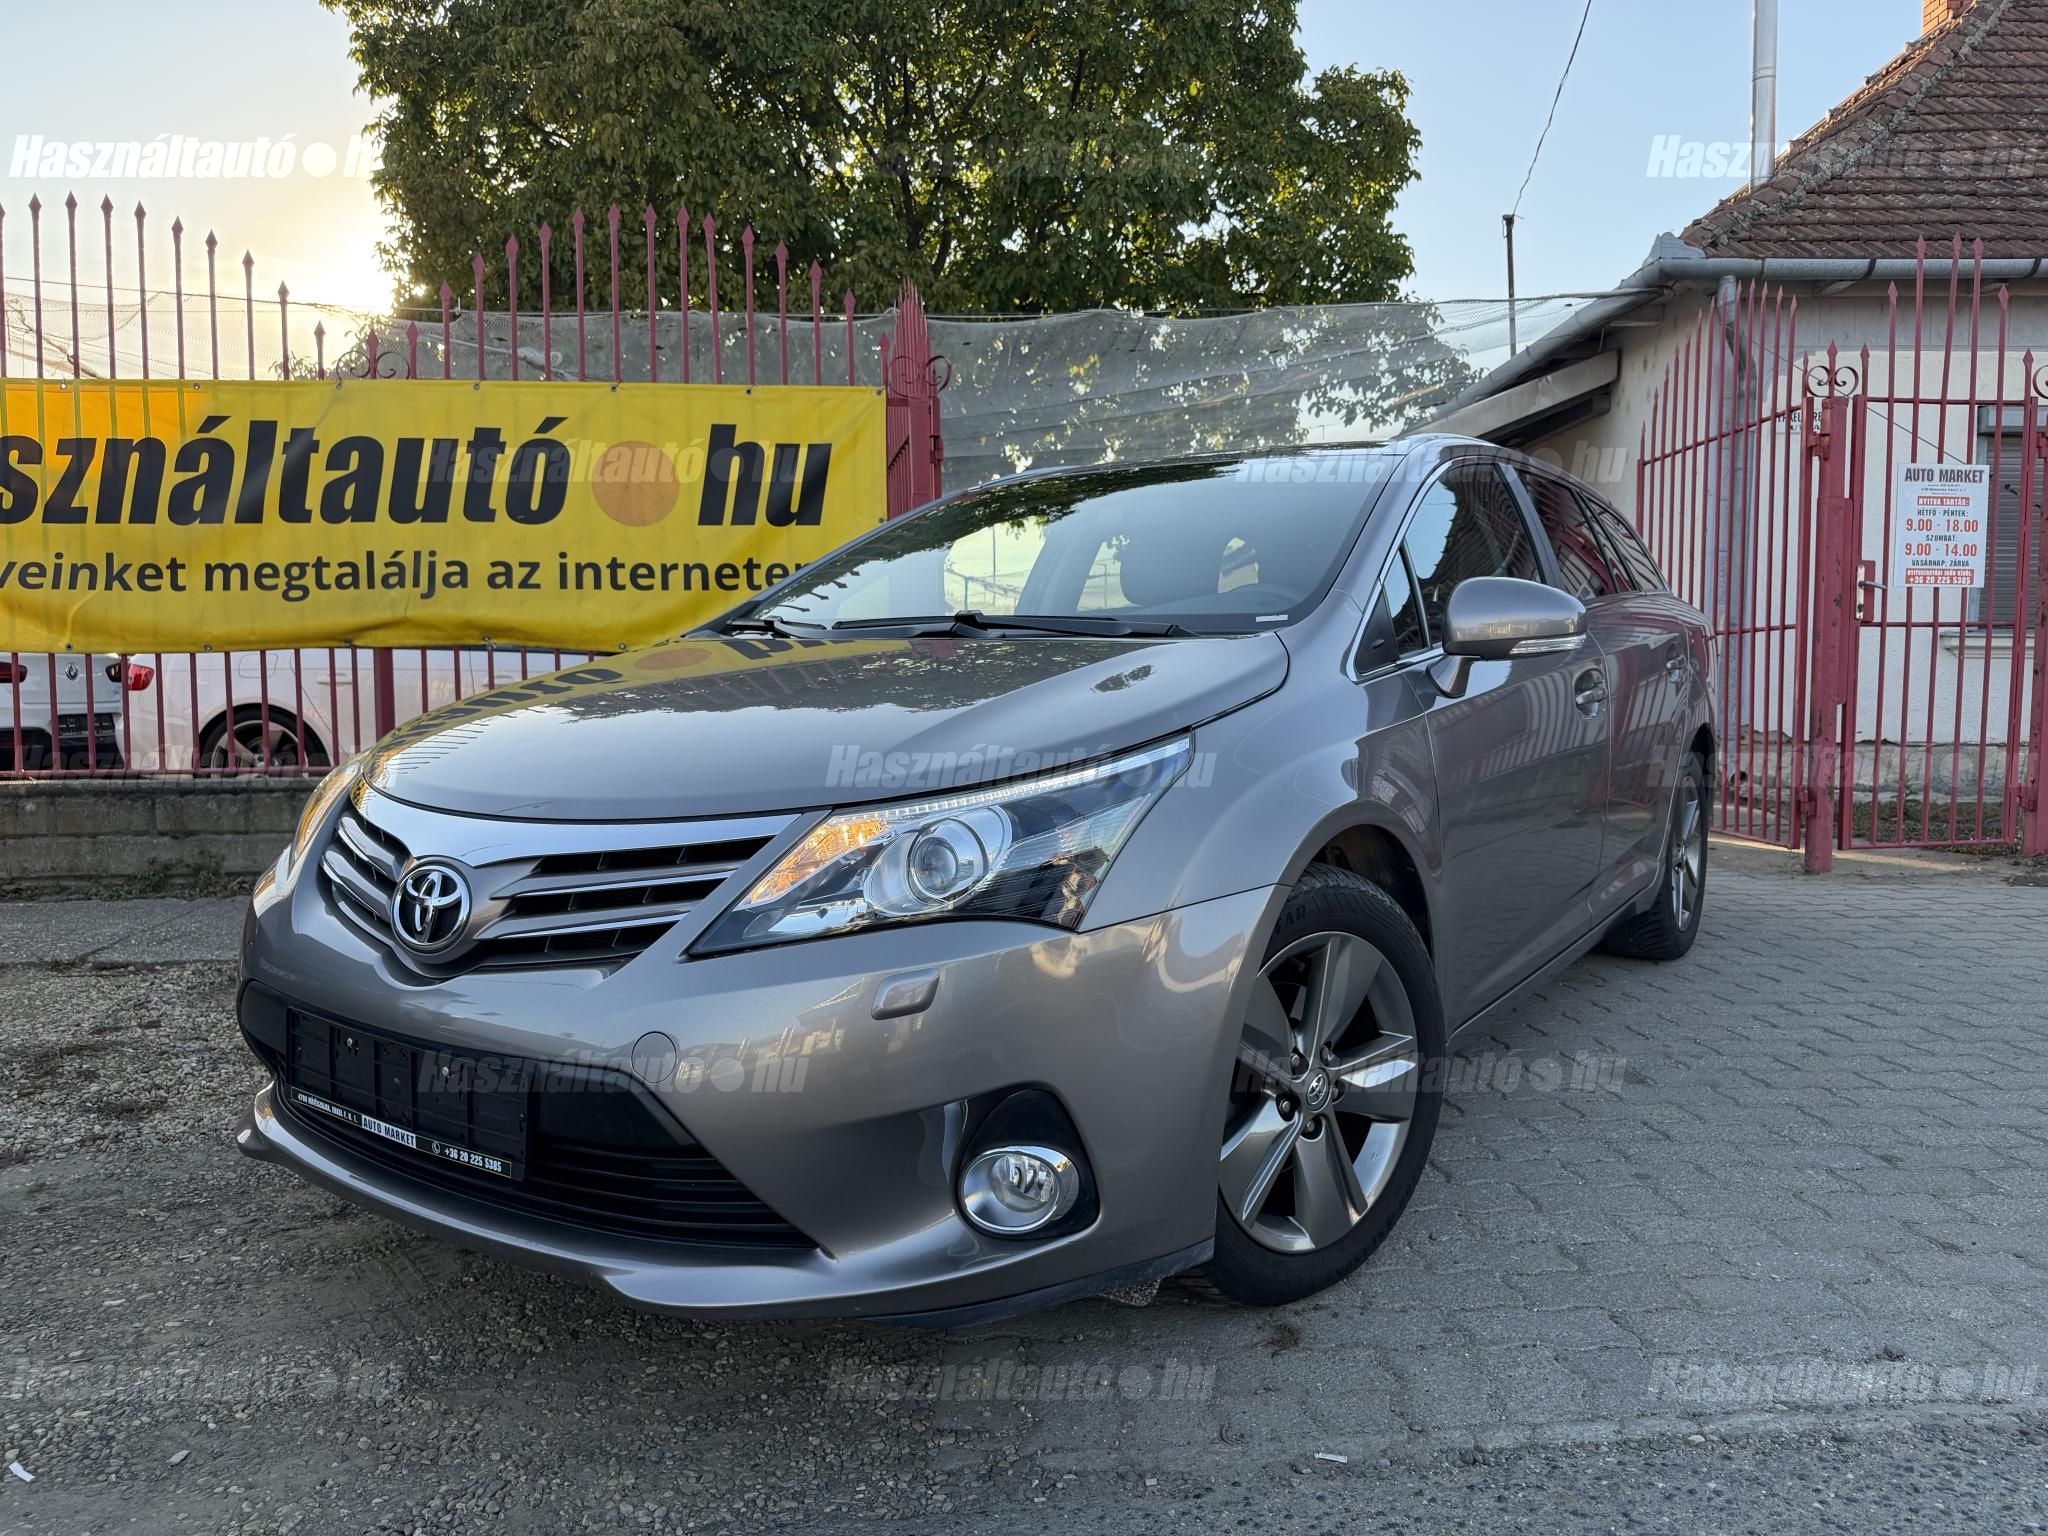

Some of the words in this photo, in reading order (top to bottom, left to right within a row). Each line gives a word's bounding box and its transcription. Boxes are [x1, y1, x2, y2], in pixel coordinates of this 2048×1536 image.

[1905, 468, 1934, 482] AUTO
[1939, 469, 1984, 483] MARKET
[1906, 519, 1932, 531] 9.00
[1946, 520, 1978, 532] 18.00
[1926, 534, 1958, 542] SZOMBAT:
[1905, 543, 1931, 556] 9.00
[1945, 544, 1977, 556] 14.00
[205, 549, 469, 602] megtalálja
[487, 556, 541, 590] az
[1937, 576, 1950, 584] 225
[364, 1117, 382, 1133] AUTO
[384, 1126, 414, 1146] MARKET
[445, 1147, 458, 1159] +36
[460, 1151, 468, 1162] 20
[470, 1154, 482, 1166] 225
